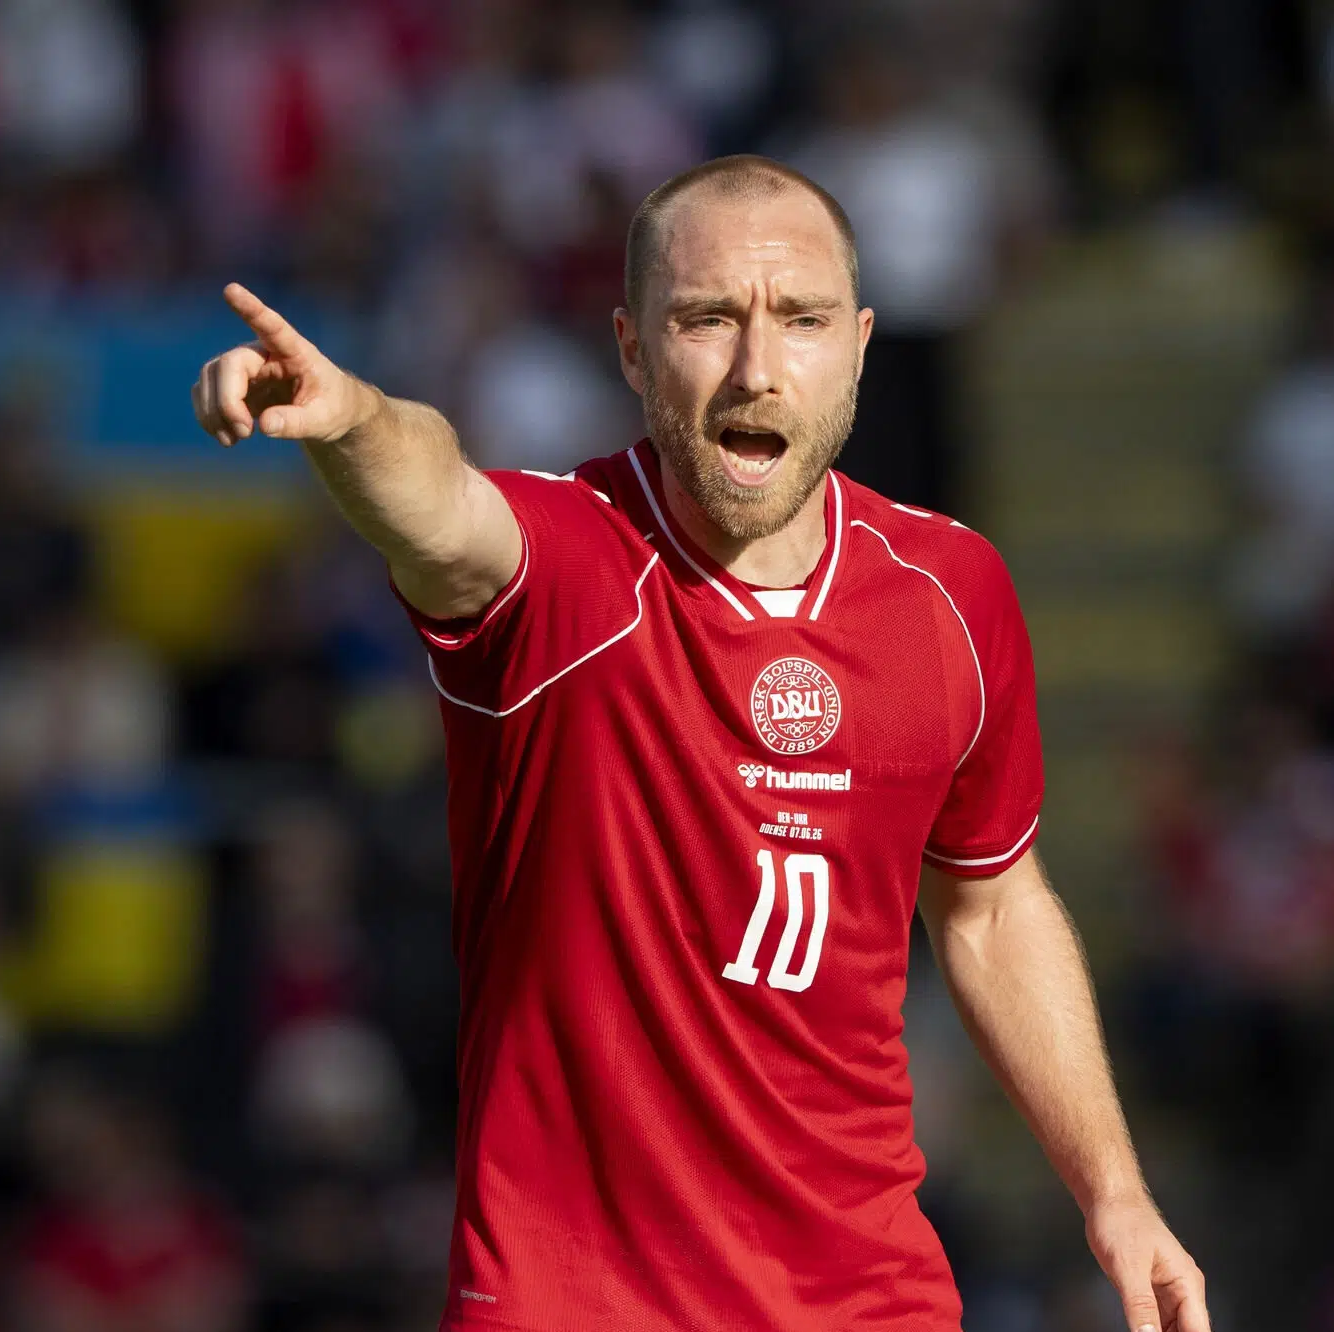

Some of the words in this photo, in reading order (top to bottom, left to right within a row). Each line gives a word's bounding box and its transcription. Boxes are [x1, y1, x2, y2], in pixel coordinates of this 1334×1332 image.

[754, 687, 778, 744] DANSK
[779, 738, 816, 753] 1889
[769, 690, 823, 720] DBU
[766, 765, 852, 791] hummel
[759, 823, 788, 837] ODENSE
[721, 848, 829, 993] 10
